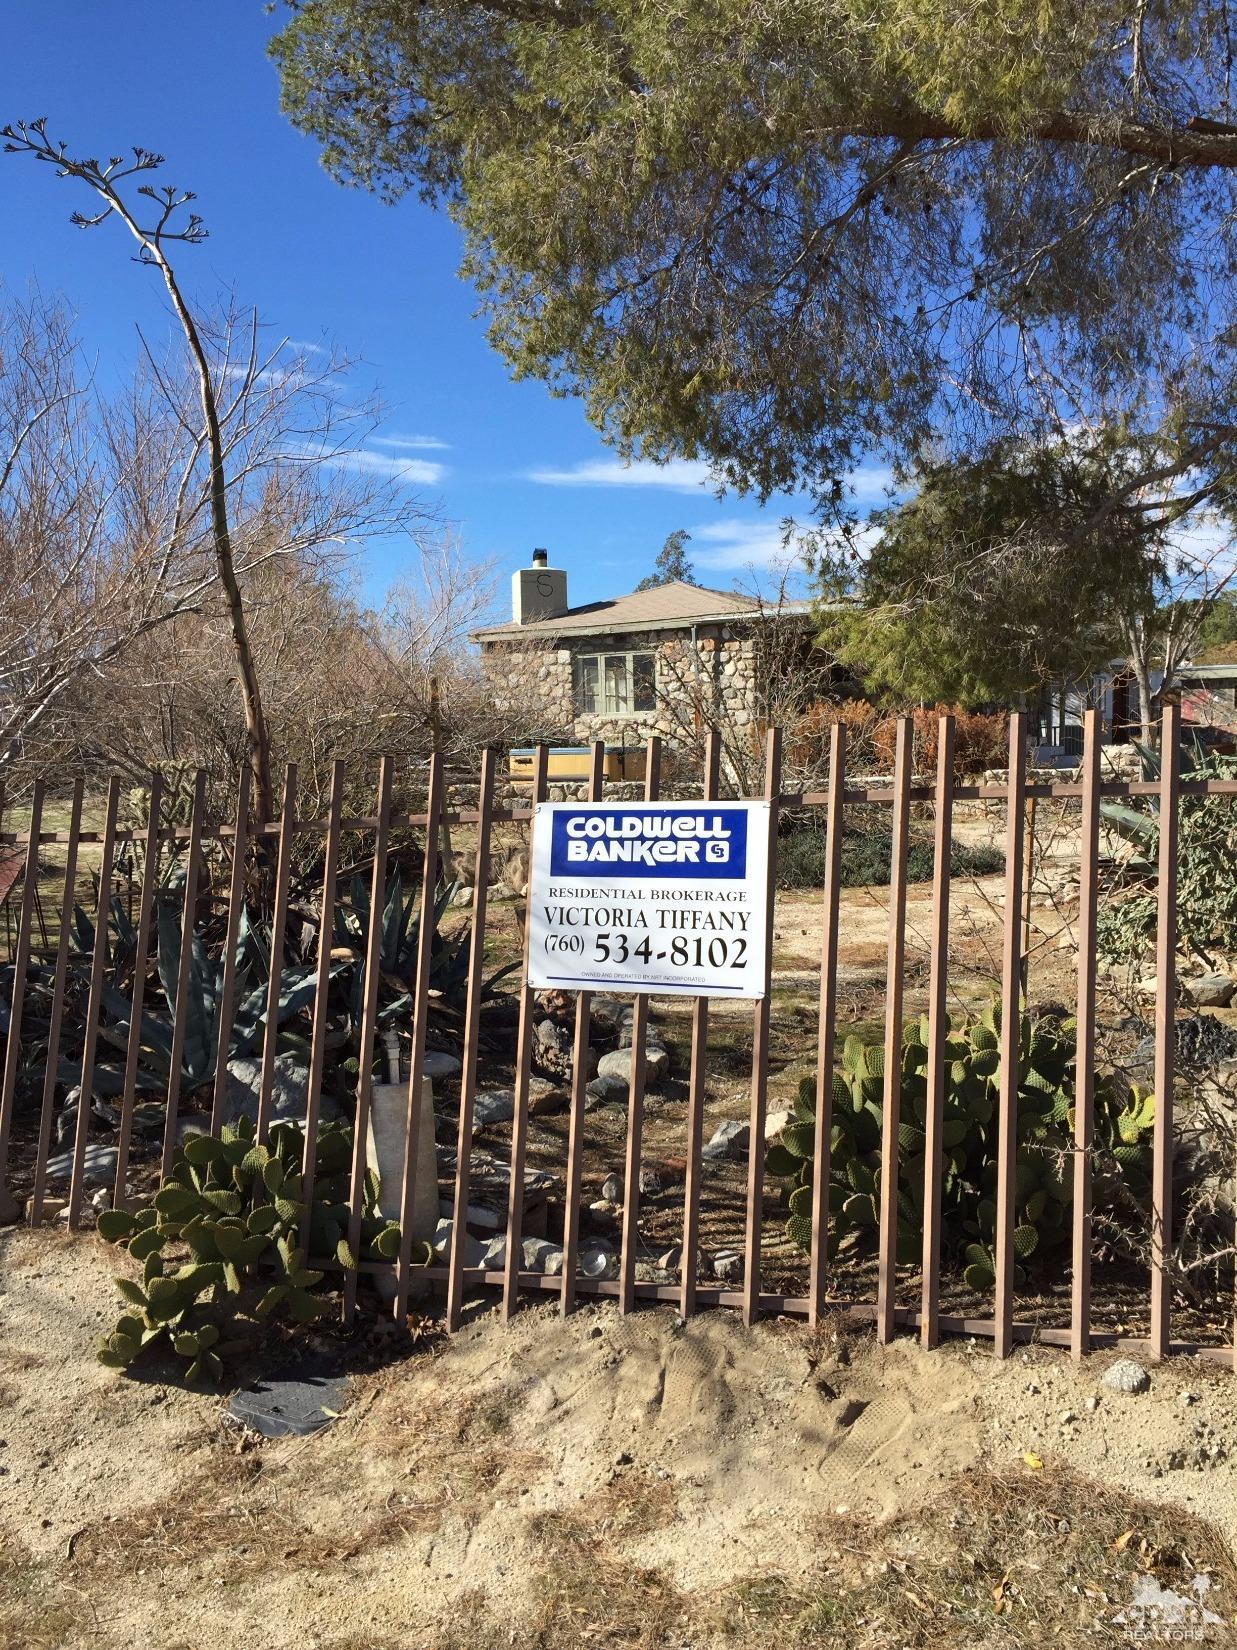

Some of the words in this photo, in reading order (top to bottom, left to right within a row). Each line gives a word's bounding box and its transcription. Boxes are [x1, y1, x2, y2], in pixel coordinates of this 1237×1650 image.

[566, 816, 732, 839] COLDWELL
[567, 840, 701, 866] BANKER
[548, 887, 646, 900] RESIDENTIAL
[650, 889, 747, 903] BROKERAGE
[543, 906, 649, 928] VICTORIA
[655, 909, 752, 932] TIFFANY
[544, 934, 585, 956] (760)
[592, 932, 748, 969] 534-8102
[663, 975, 706, 983] INCORPORATED
